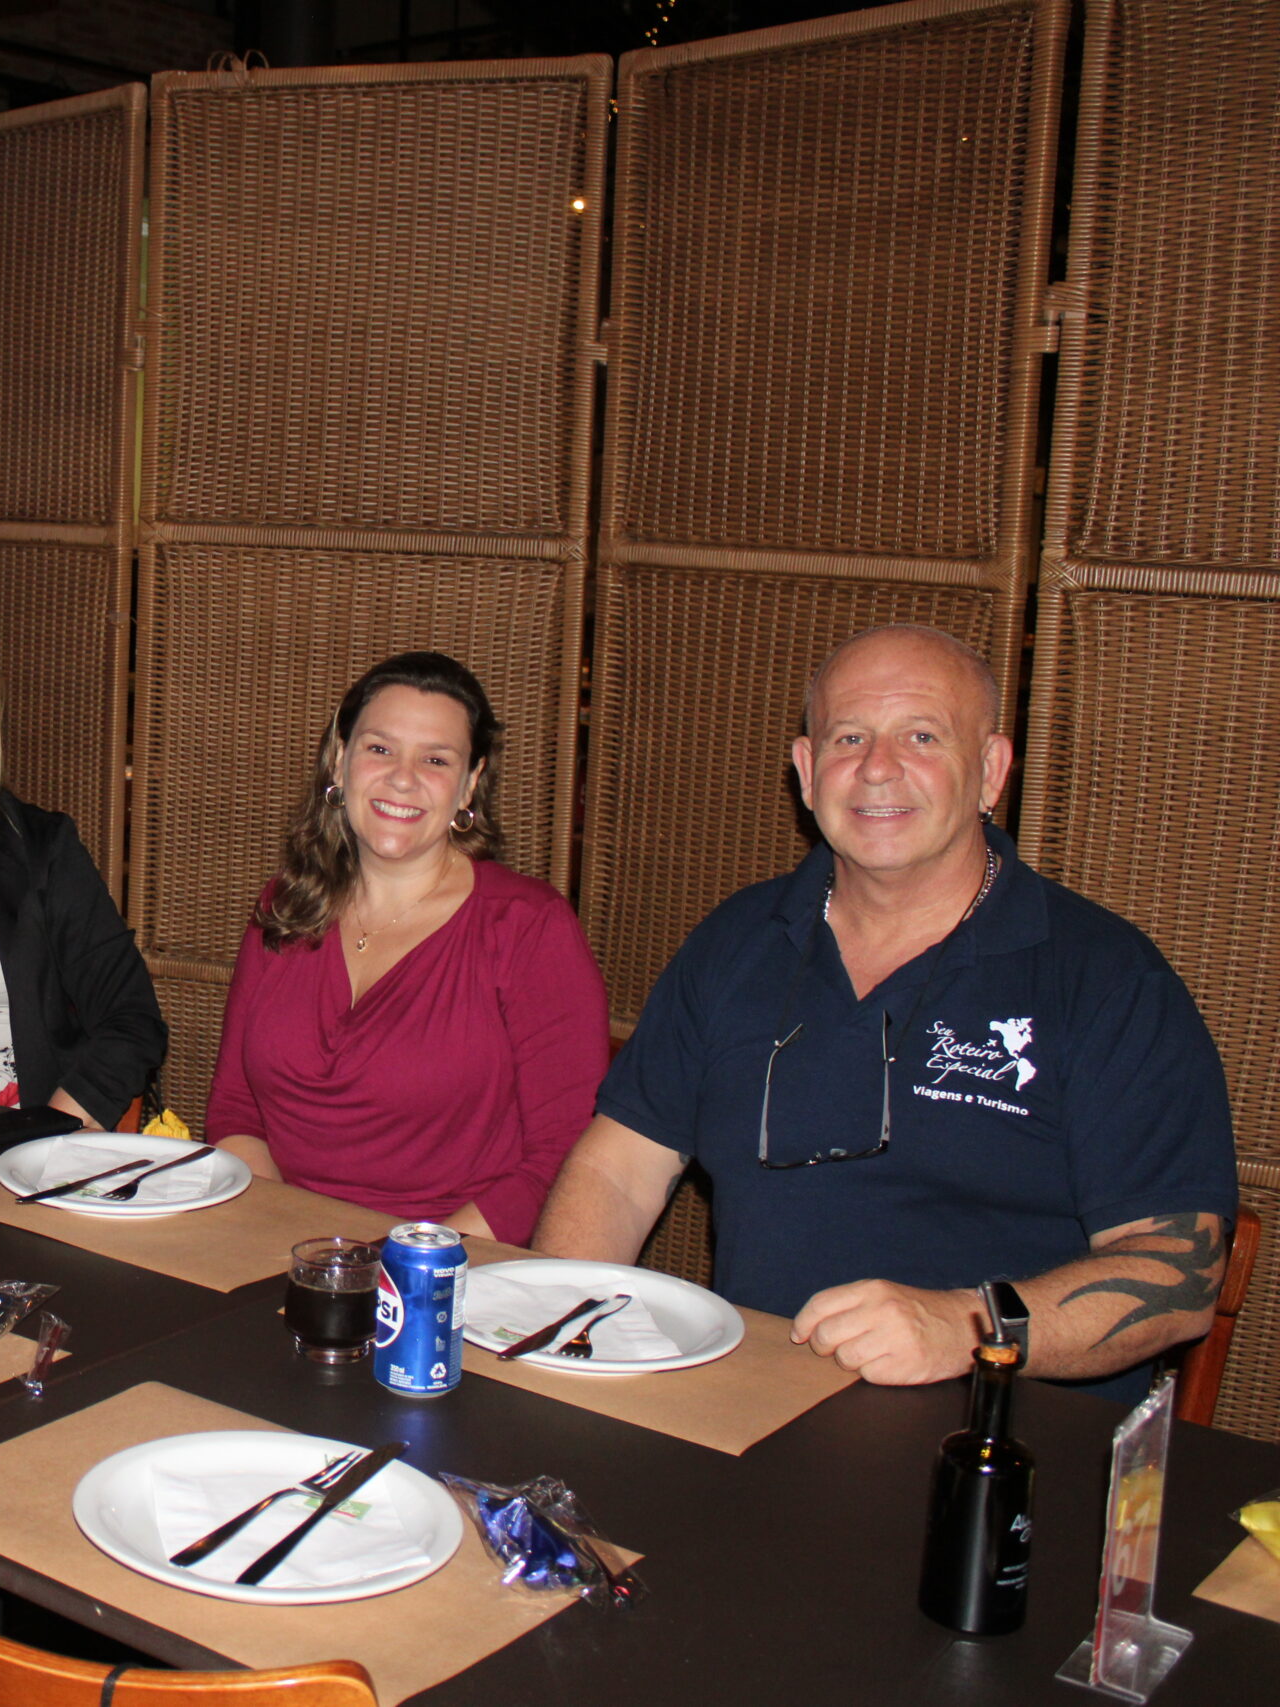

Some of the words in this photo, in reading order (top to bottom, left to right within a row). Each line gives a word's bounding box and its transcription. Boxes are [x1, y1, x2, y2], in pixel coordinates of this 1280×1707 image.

[926, 1021, 956, 1036] Seu
[931, 1037, 1004, 1060] Roteiro
[926, 1053, 1018, 1084] Especial
[913, 1085, 962, 1101] Viagens
[964, 1093, 974, 1103] e
[976, 1095, 1029, 1116] Turismo
